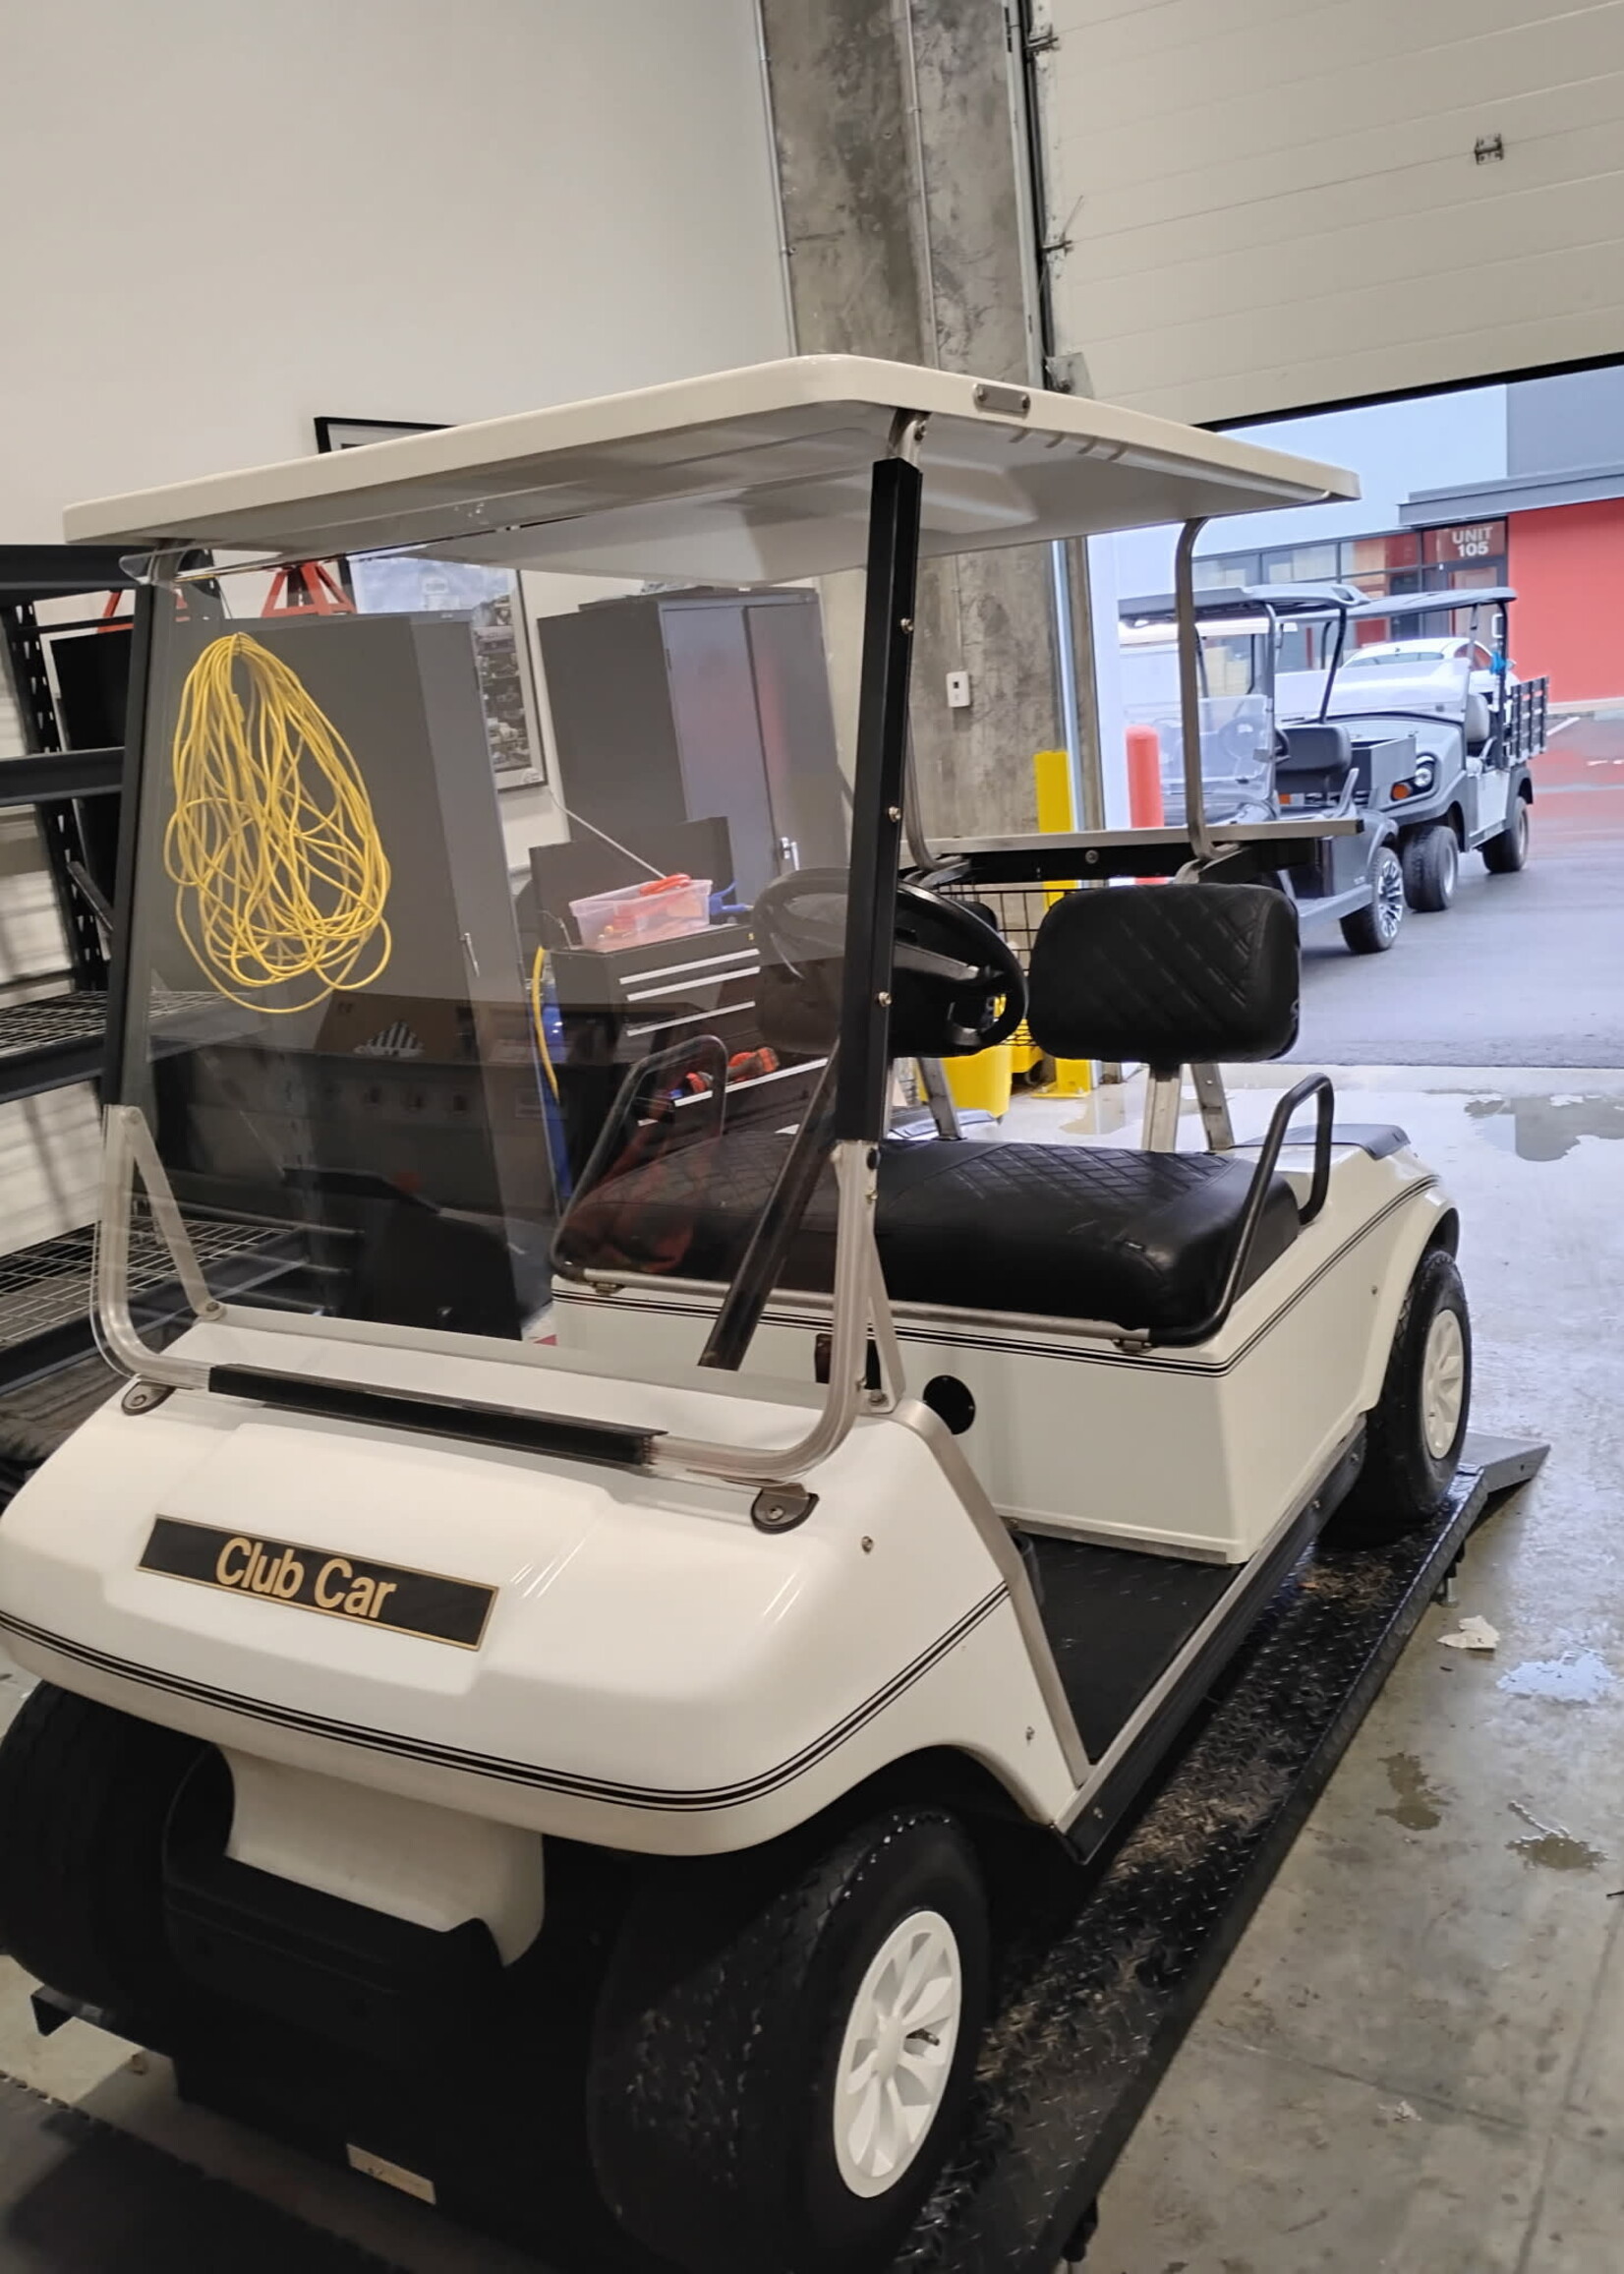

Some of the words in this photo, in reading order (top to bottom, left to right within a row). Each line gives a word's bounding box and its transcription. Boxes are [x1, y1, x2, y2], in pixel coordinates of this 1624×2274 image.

[1452, 526, 1493, 545] UNIT
[1458, 542, 1489, 557] 105
[215, 1537, 306, 1600] Club
[314, 1558, 397, 1619] Car
